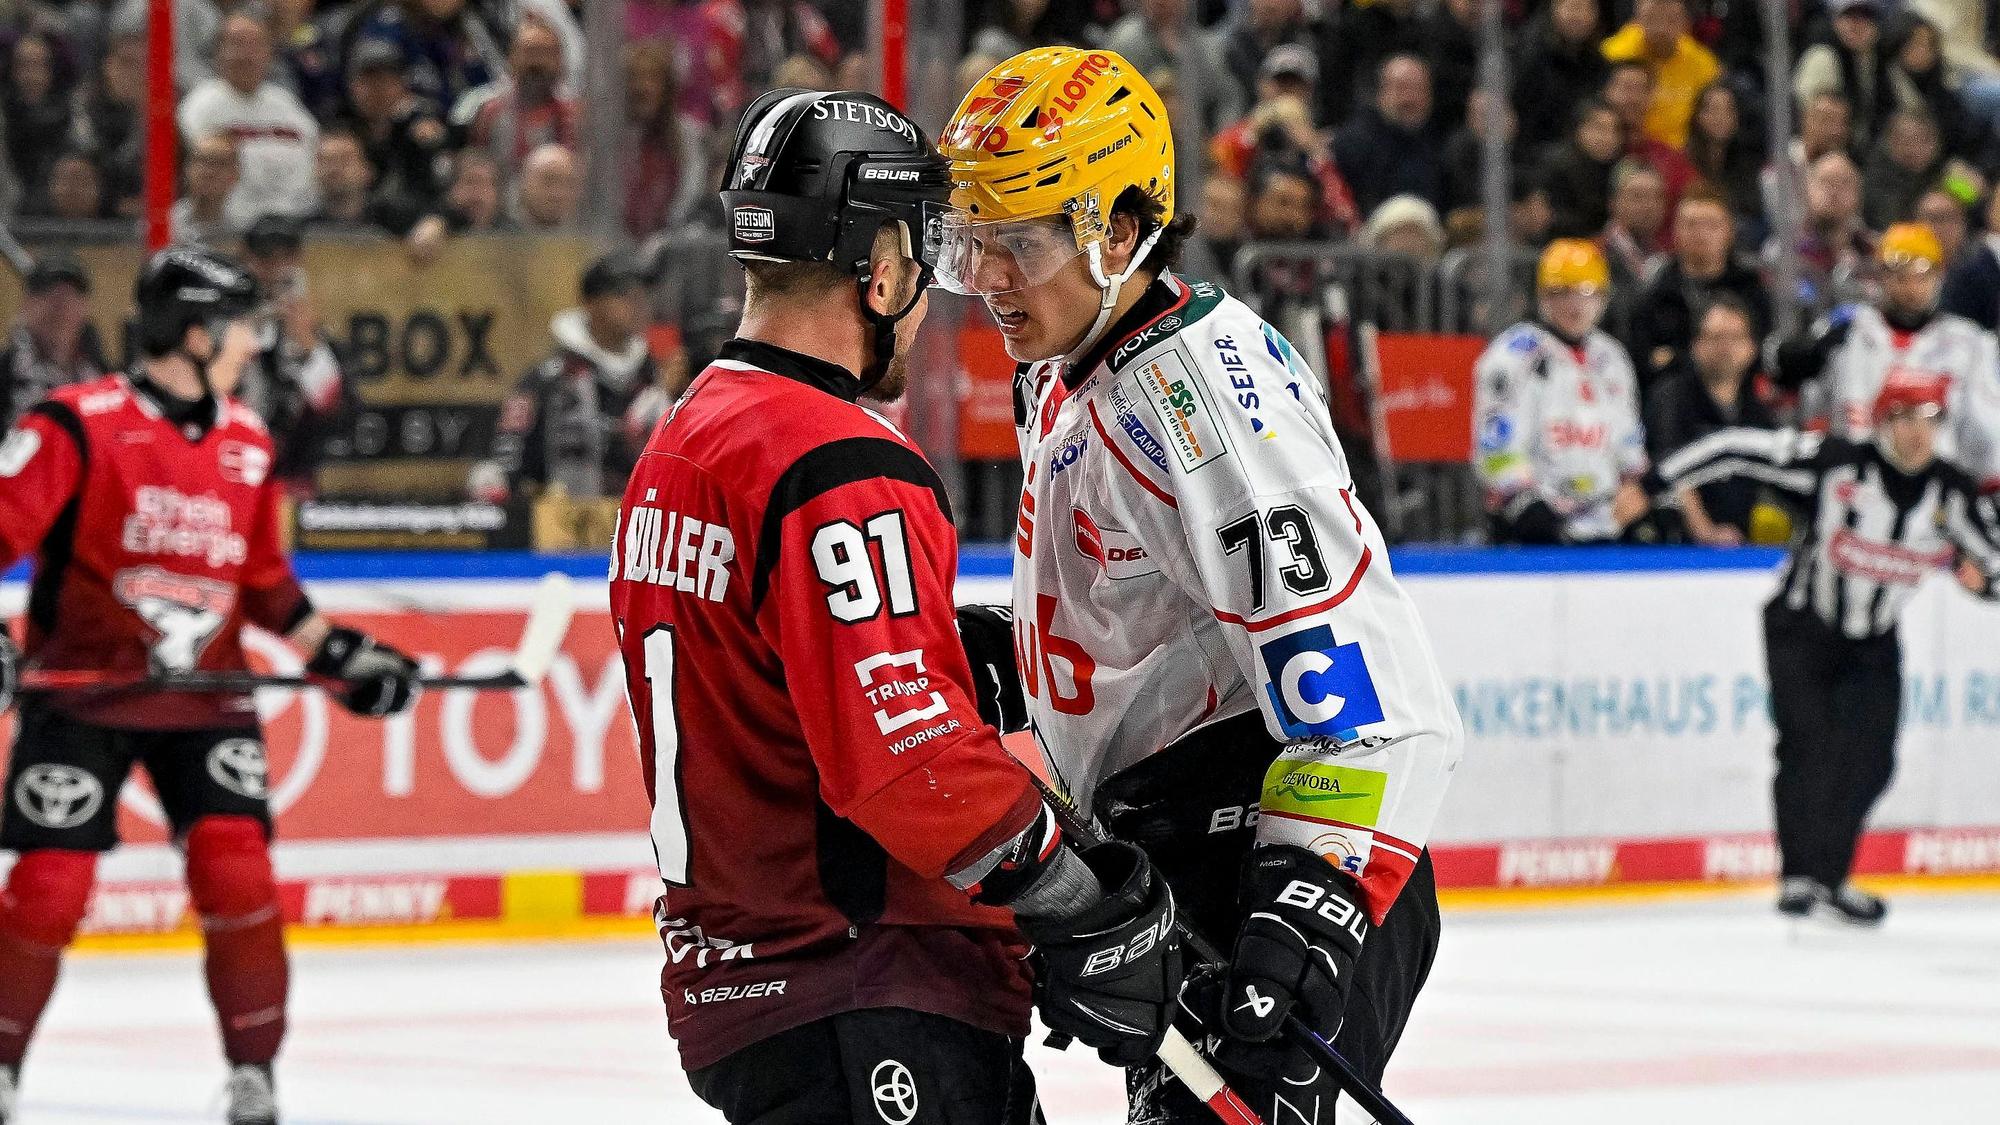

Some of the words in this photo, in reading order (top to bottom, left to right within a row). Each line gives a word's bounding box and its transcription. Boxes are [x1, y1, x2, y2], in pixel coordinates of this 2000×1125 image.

[1053, 54, 1111, 113] LOTTO
[813, 100, 918, 143] STETSON
[736, 211, 771, 227] STETSON
[350, 308, 501, 378] BOX
[1114, 326, 1160, 368] AOK
[1109, 383, 1127, 414] Nordic
[1169, 379, 1197, 418] BSG
[1131, 427, 1169, 469] CAMPU
[1159, 397, 1197, 464] Sandhandel
[812, 509, 919, 624] 91
[1216, 503, 1333, 615] 73
[381, 648, 628, 798] TOY
[1453, 672, 1720, 738] NKENHAUS
[1499, 840, 1617, 886] PENNY
[1906, 826, 2000, 873] PENN
[302, 881, 449, 927] PENNY
[1273, 879, 1369, 946] BAU
[701, 980, 787, 1004] BAUER
